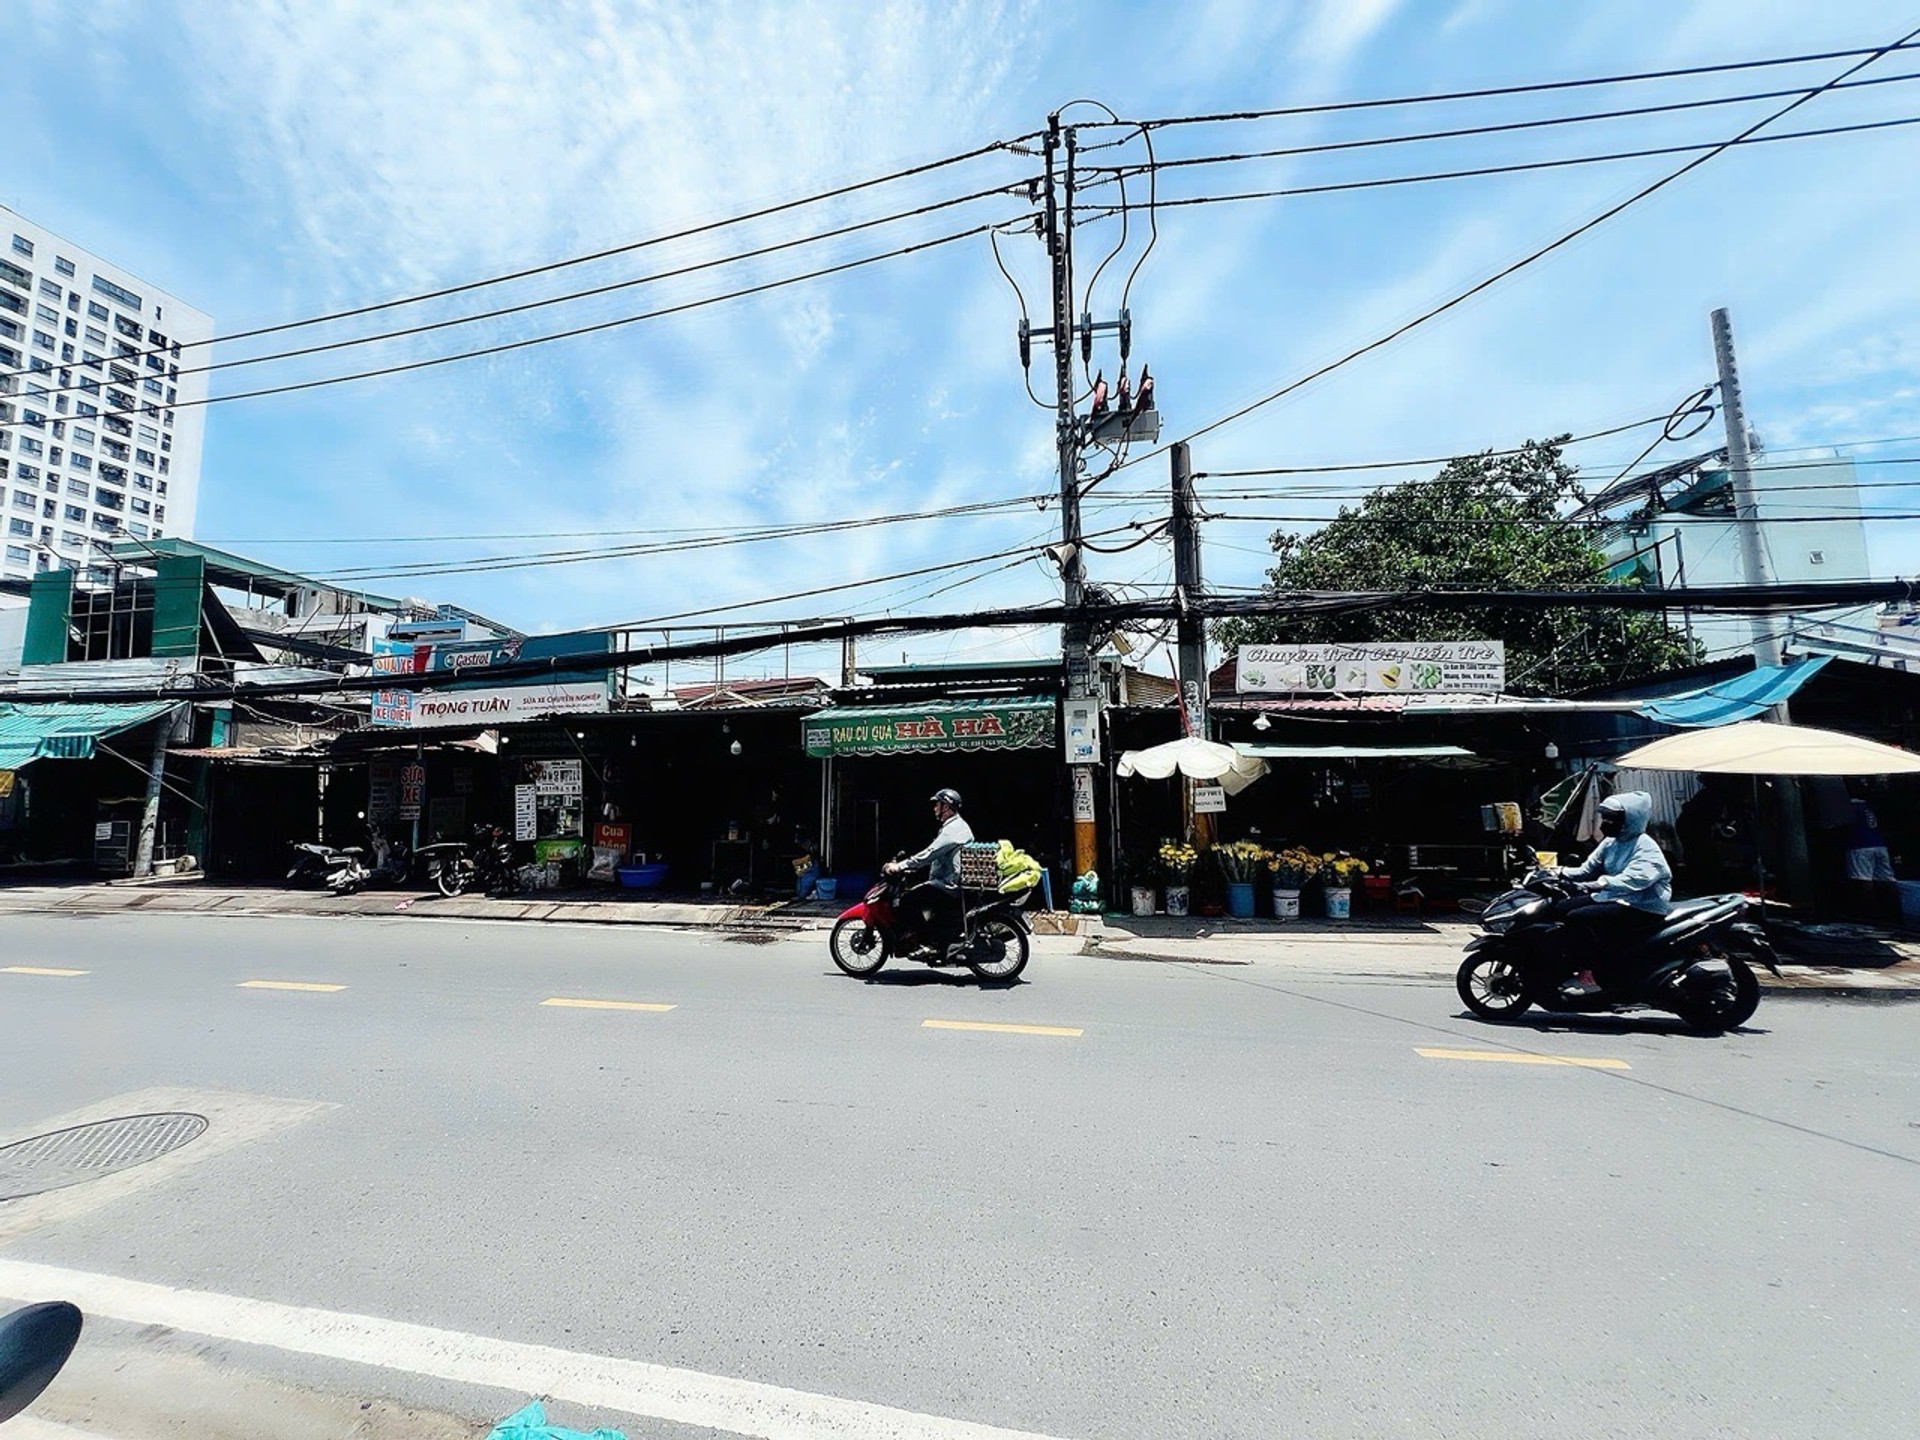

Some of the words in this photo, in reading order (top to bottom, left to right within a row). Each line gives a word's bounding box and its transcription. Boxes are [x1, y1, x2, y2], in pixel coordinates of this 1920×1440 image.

[456, 653, 489, 667] Castrol
[1412, 644, 1453, 660] Bến
[1459, 646, 1495, 660] Tre
[420, 701, 468, 718] TRỌNG
[833, 727, 853, 743] RAU
[856, 720, 868, 742] CỦ
[871, 719, 893, 742] QUẢ
[895, 716, 947, 740] HÀ
[952, 712, 1006, 738] HÀ
[404, 786, 420, 804] XE
[602, 825, 624, 837] Cua
